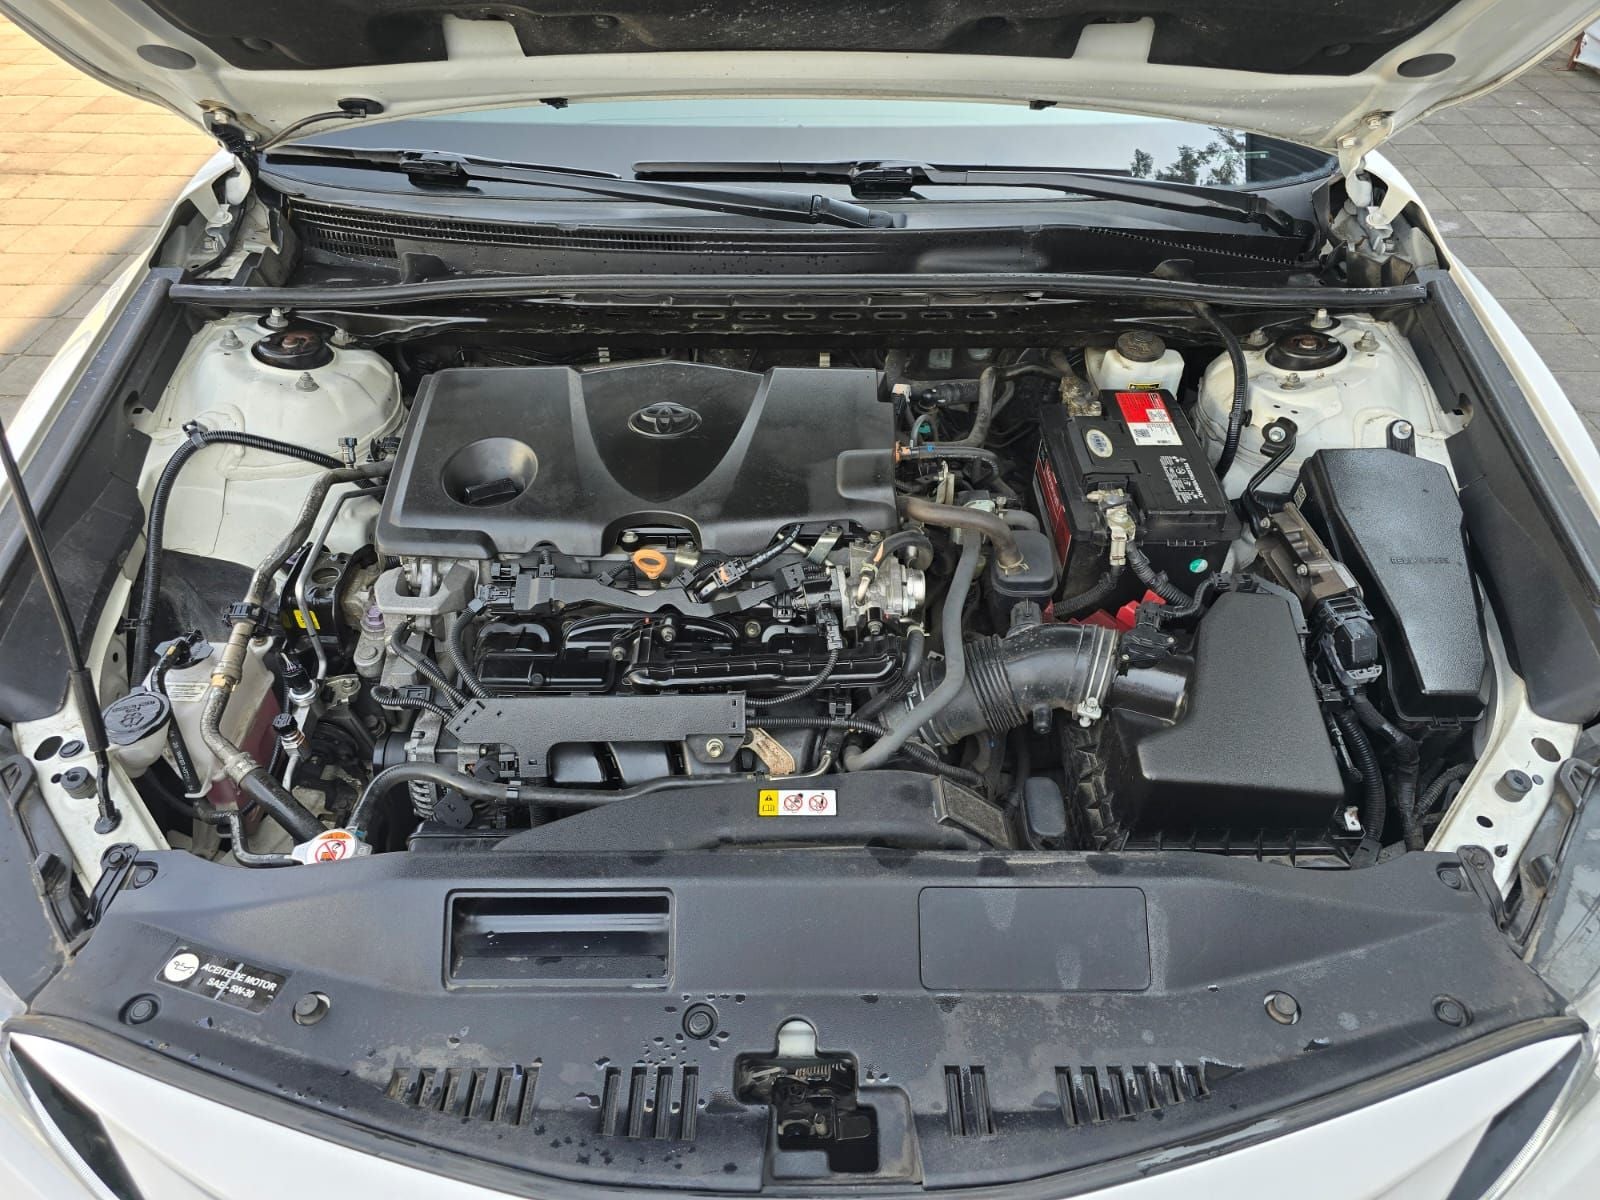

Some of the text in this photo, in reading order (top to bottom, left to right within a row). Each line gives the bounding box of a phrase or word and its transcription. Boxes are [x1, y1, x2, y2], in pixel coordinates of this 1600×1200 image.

[200, 963, 278, 992] ACEITE DE MOTOR
[206, 977, 227, 990] SAE
